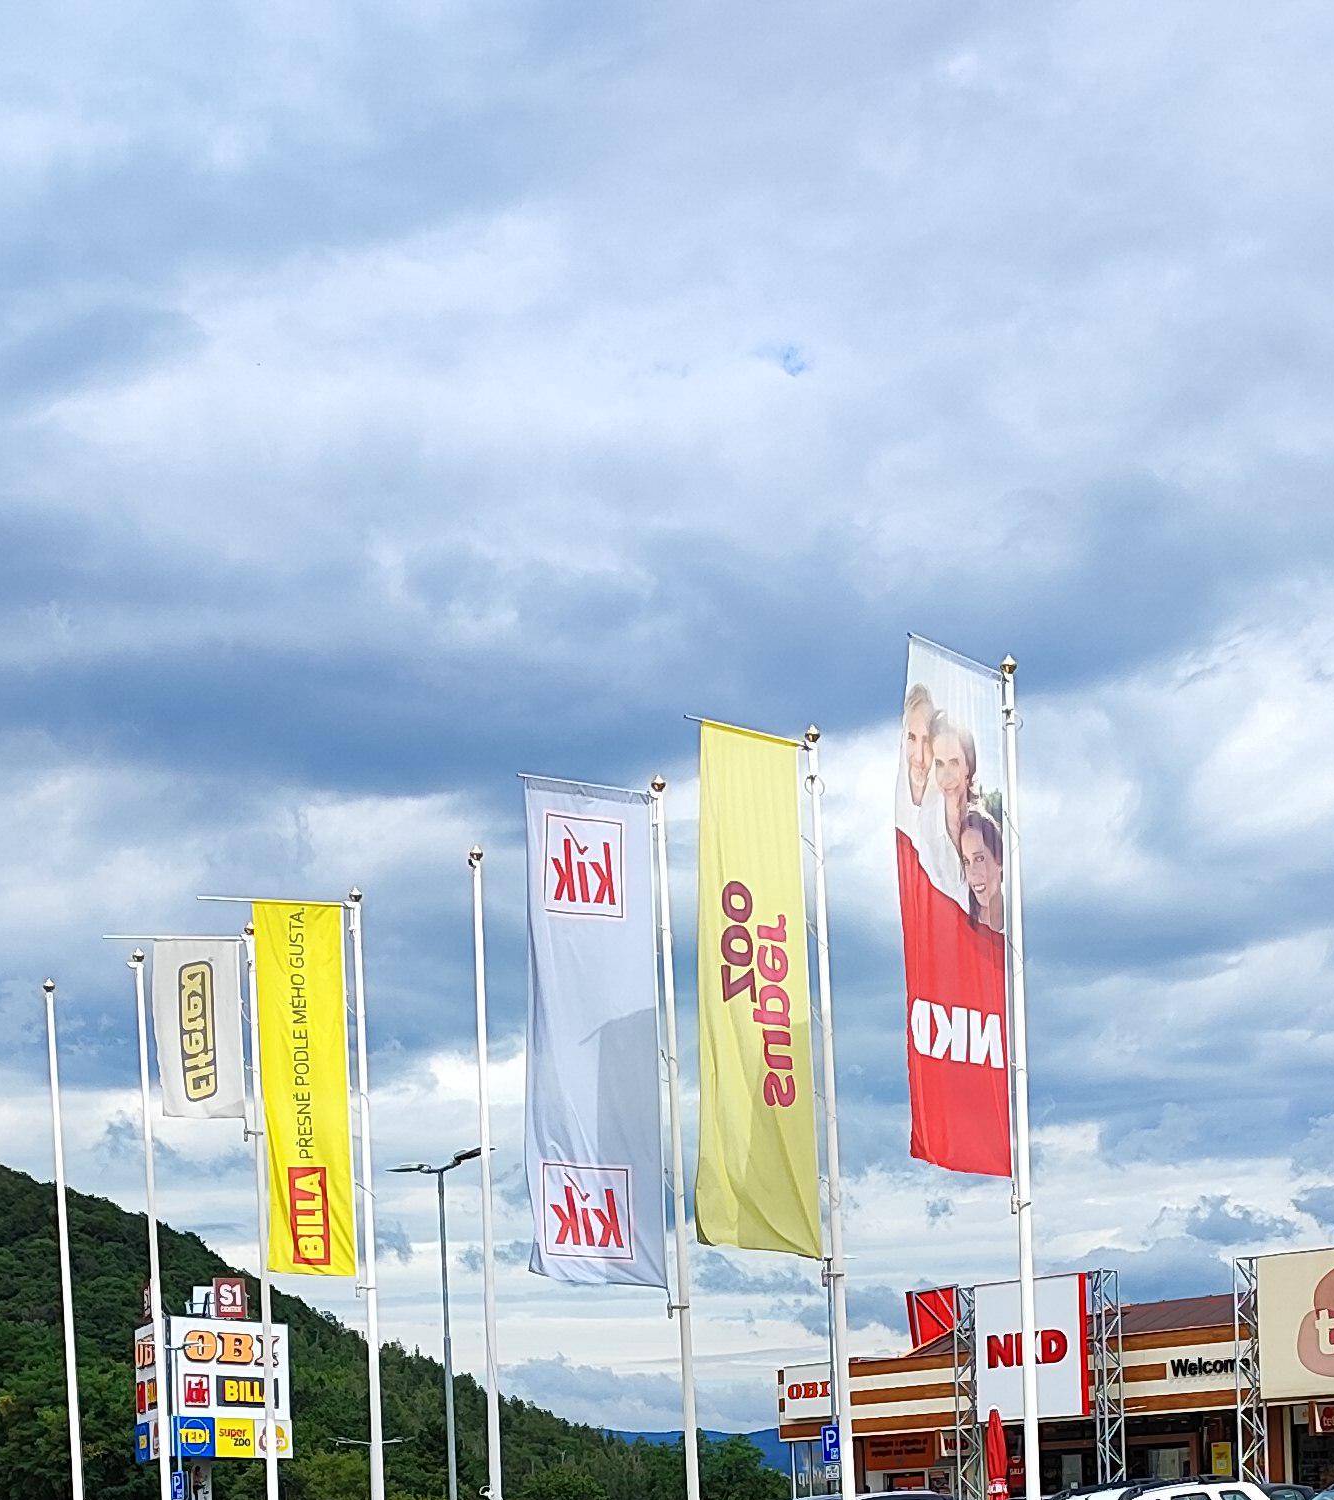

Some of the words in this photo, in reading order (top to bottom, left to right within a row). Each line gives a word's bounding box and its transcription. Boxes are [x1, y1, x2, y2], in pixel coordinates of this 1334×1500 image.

[288, 906, 307, 969] GUSTA.
[288, 973, 308, 1025] MÉHO
[292, 1029, 311, 1087] PODLE
[292, 1092, 315, 1160] PŘESNĚ
[293, 1171, 327, 1261] BILLA
[219, 1283, 243, 1306] S1
[224, 1379, 266, 1403] BILL
[787, 1380, 831, 1400] OBI
[218, 1428, 247, 1440] super
[825, 1429, 837, 1452] P
[173, 1475, 181, 1492] P
